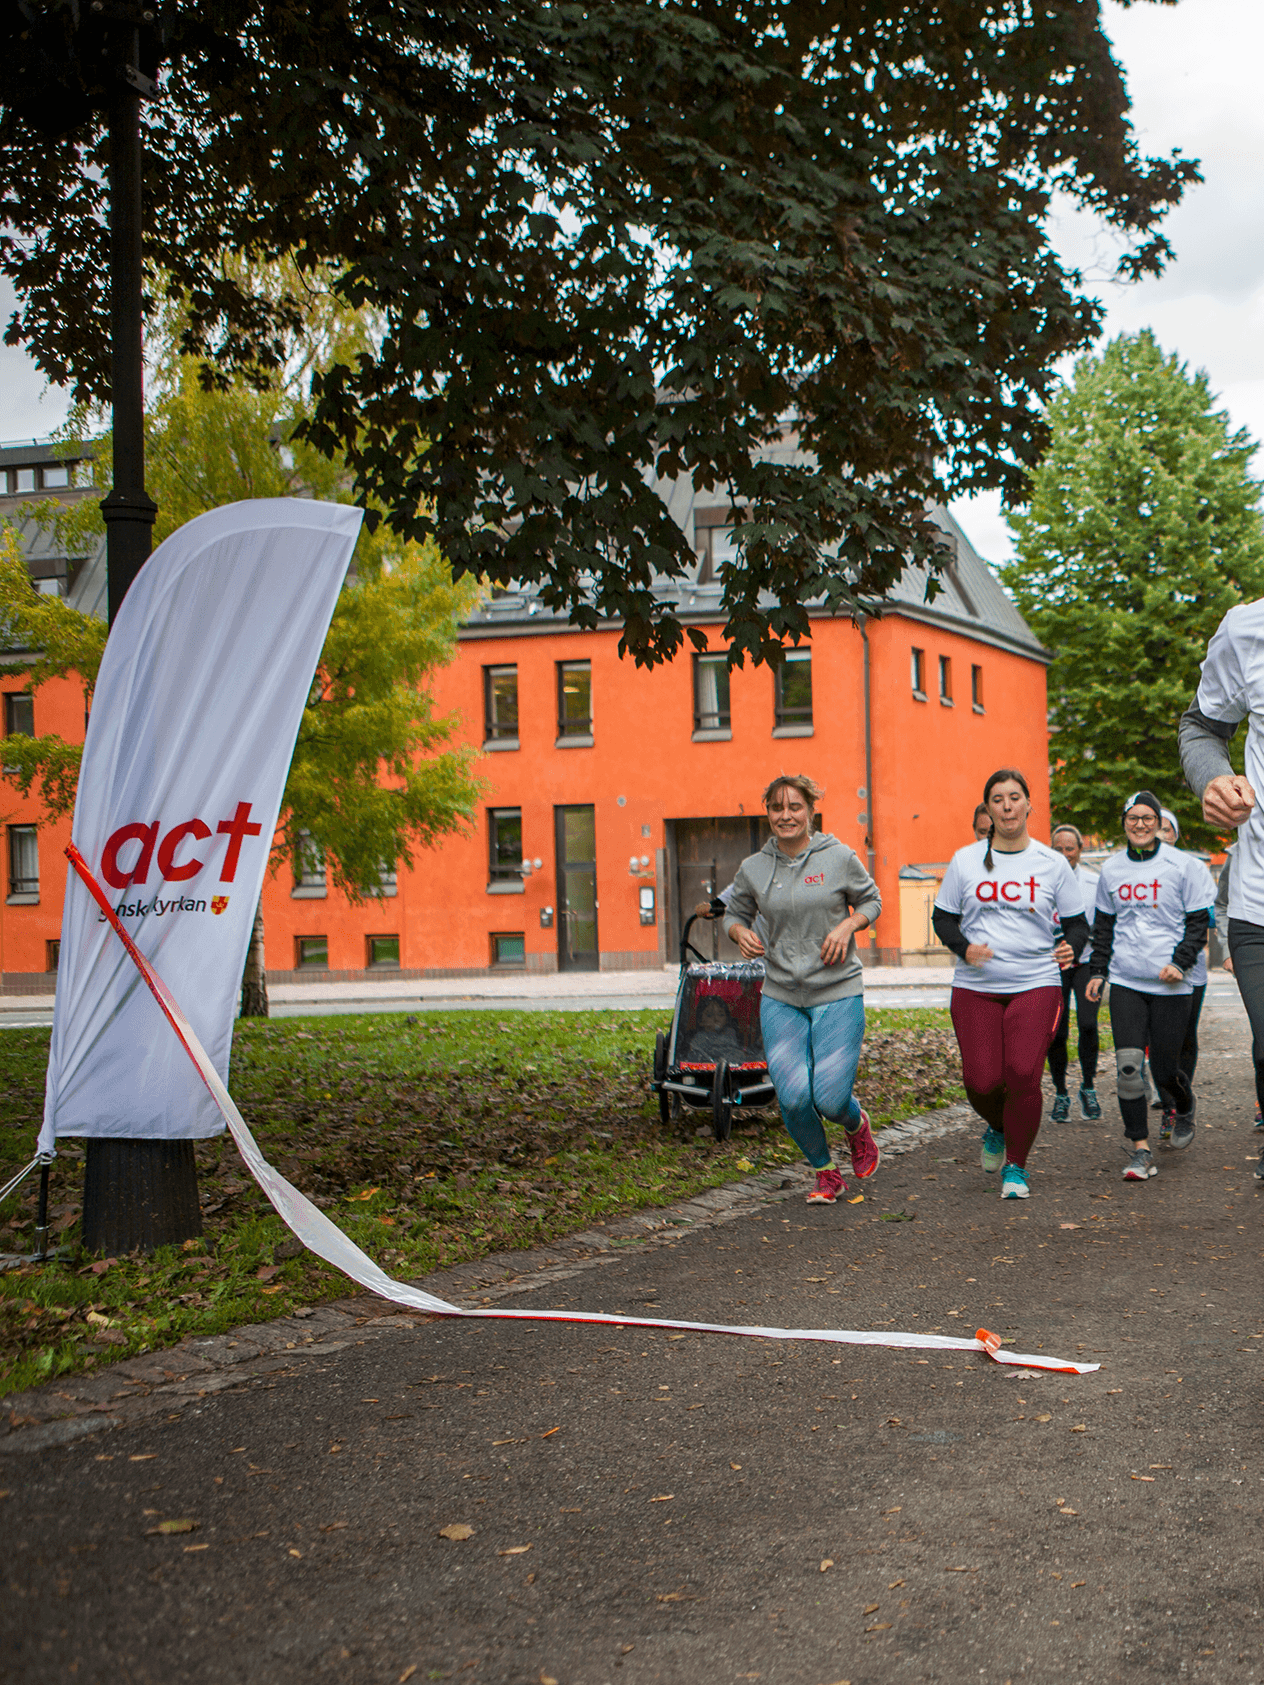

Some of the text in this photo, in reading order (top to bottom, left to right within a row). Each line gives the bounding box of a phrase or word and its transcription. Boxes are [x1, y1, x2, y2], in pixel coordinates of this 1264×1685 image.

[100, 801, 262, 889] act
[804, 872, 825, 884] act
[976, 876, 1040, 903] act
[1118, 879, 1162, 901] act
